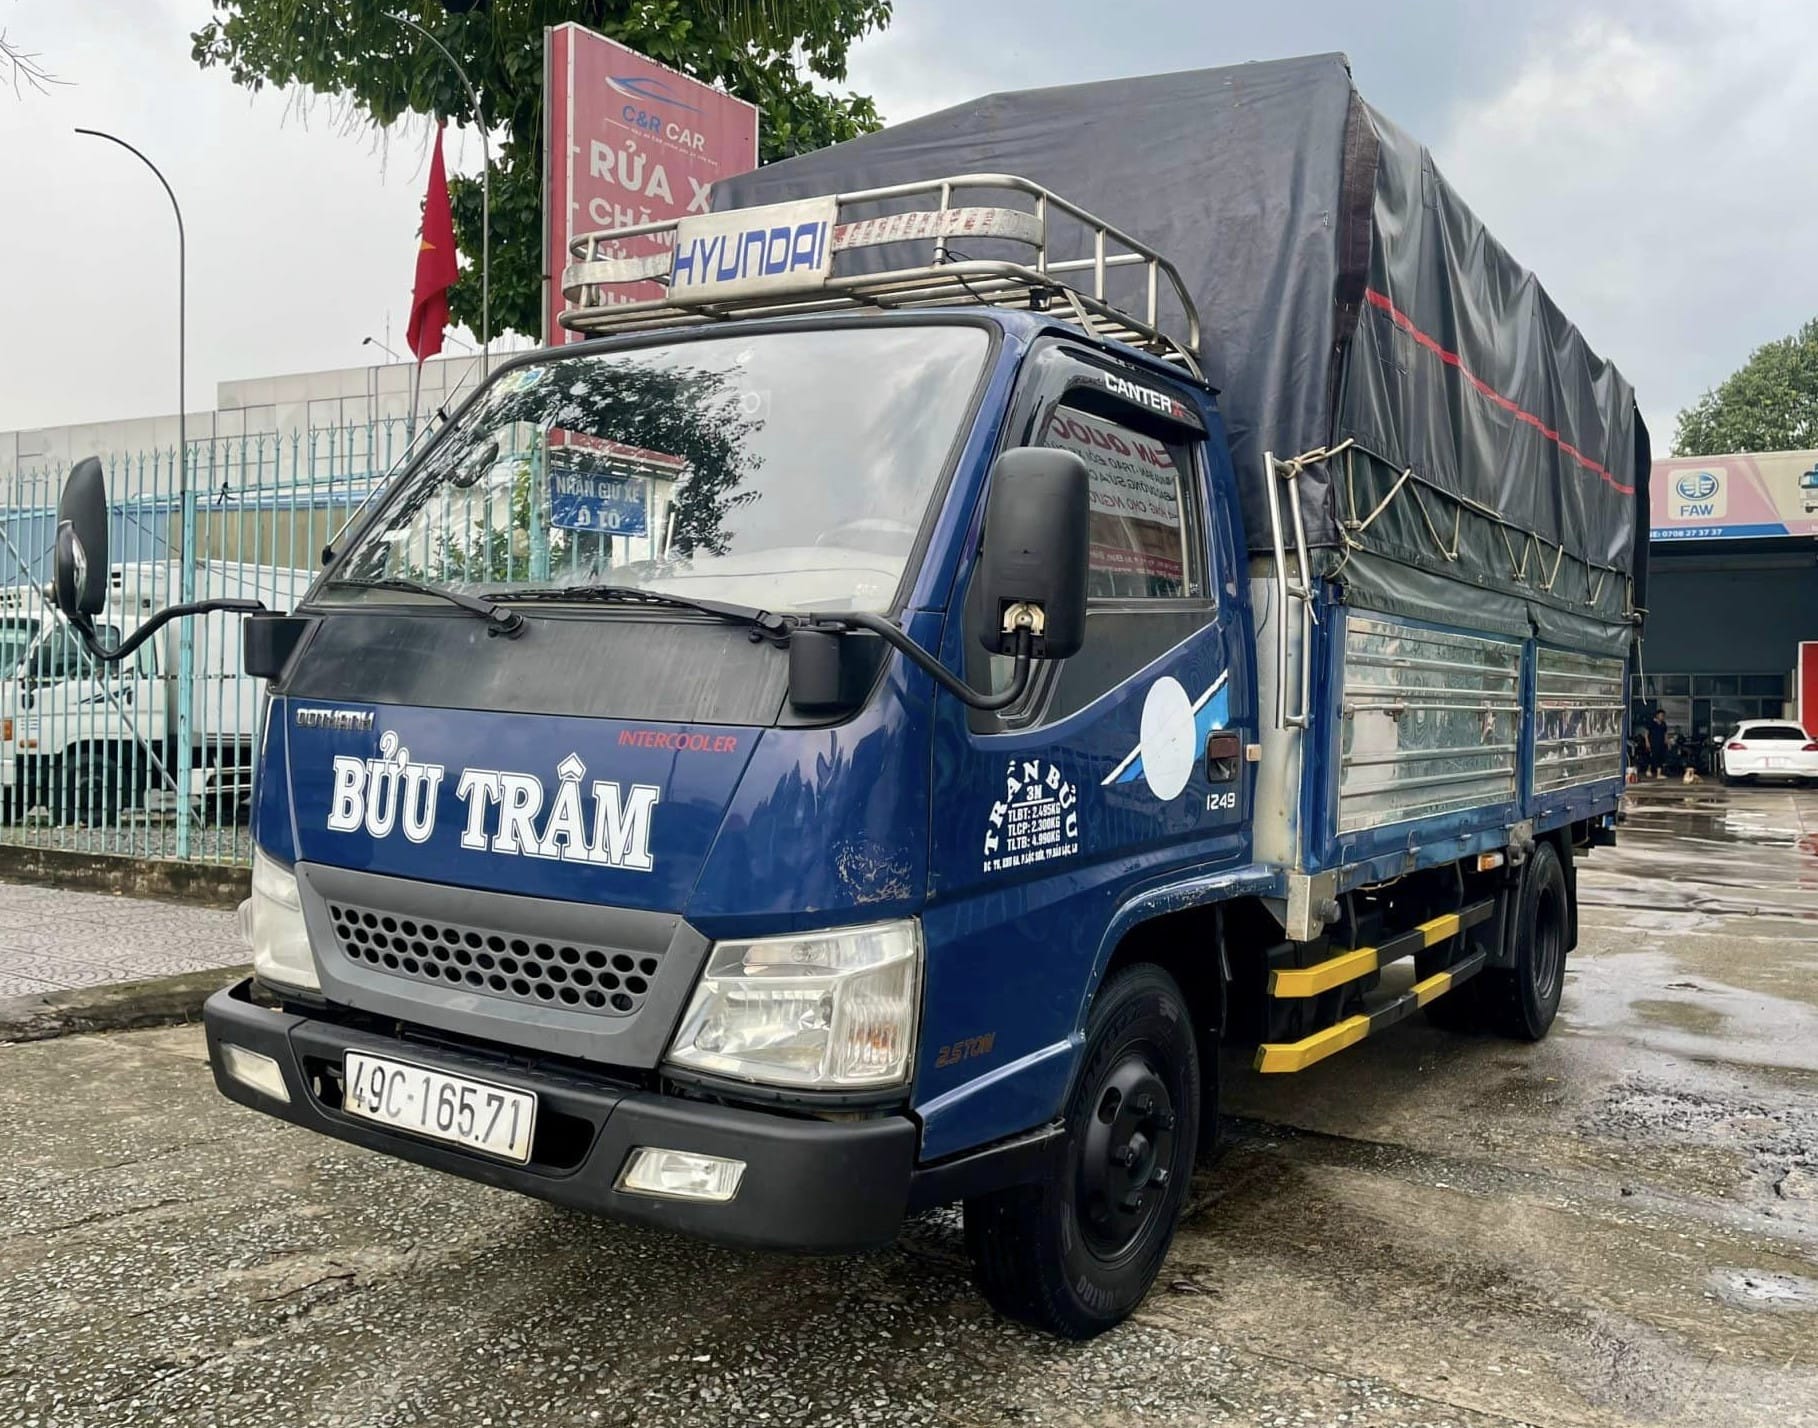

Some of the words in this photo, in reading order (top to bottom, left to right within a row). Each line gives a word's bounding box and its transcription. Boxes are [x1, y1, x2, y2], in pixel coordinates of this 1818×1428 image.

[623, 105, 661, 133] C&R
[666, 122, 705, 152] CAR
[590, 139, 674, 205] RỬA
[669, 221, 828, 288] HYUNDAI
[1104, 372, 1173, 415] CANTER
[1680, 504, 1714, 516] FAW
[618, 730, 737, 753] INTERCOOLER
[327, 729, 444, 844] BỬU
[455, 751, 660, 872] TRÂM
